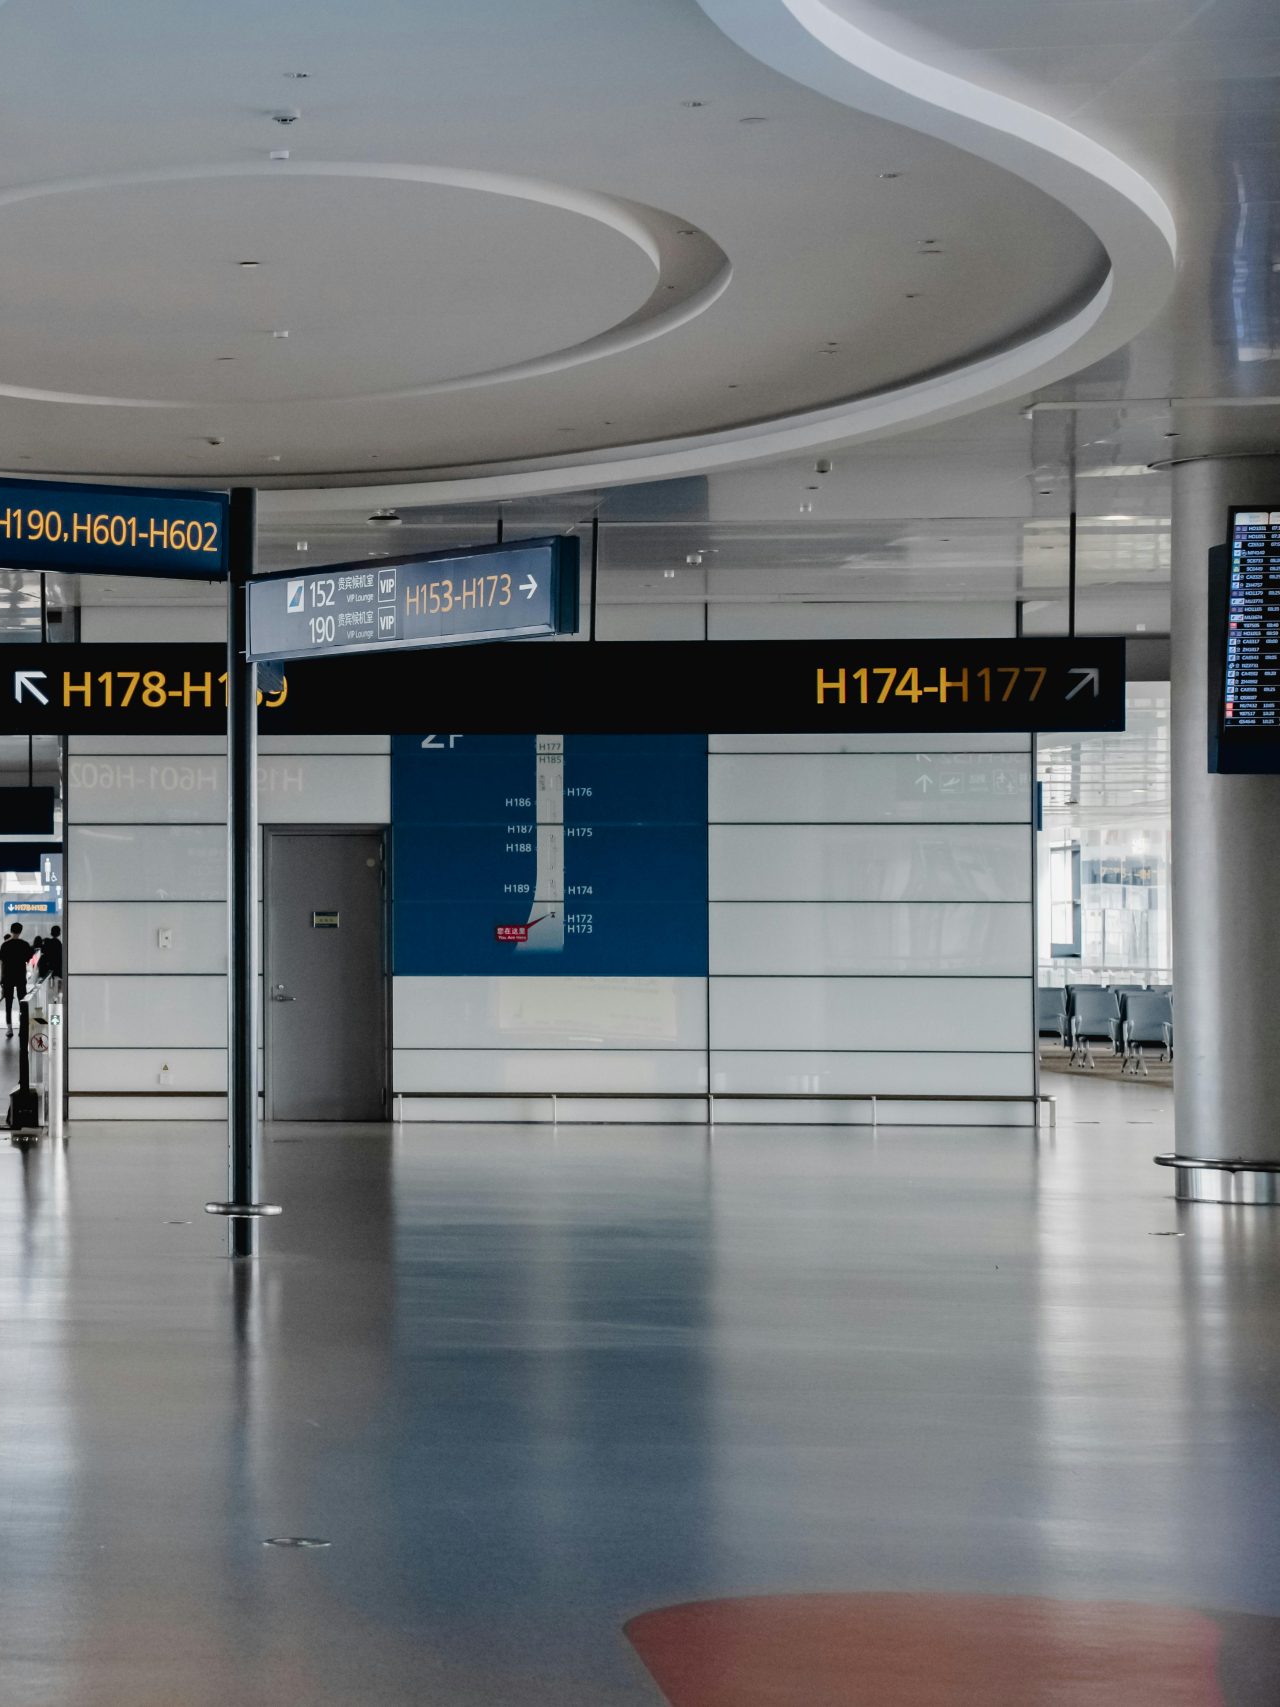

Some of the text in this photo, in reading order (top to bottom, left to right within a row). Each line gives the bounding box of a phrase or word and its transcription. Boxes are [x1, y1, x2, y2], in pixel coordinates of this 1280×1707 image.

[338, 574, 374, 591] 贵宾候机室
[380, 579, 395, 594] VIP
[309, 580, 335, 608] 152
[355, 594, 374, 602] Lounge
[406, 574, 512, 616] H153-H173
[338, 610, 374, 627] 贵宾候机室
[380, 616, 395, 630] VIP
[309, 616, 335, 643] 190
[63, 671, 288, 707] H178-H19
[817, 667, 1047, 704] H174-H177
[539, 743, 561, 751] H177
[539, 756, 562, 764] H185
[568, 788, 592, 797] H176
[505, 798, 531, 807] H186
[507, 825, 533, 834] H187
[568, 828, 593, 837] H175
[506, 844, 532, 852] H188
[504, 884, 530, 893] H189
[568, 886, 593, 895] H174
[568, 915, 593, 923] H172
[568, 925, 593, 934] H173
